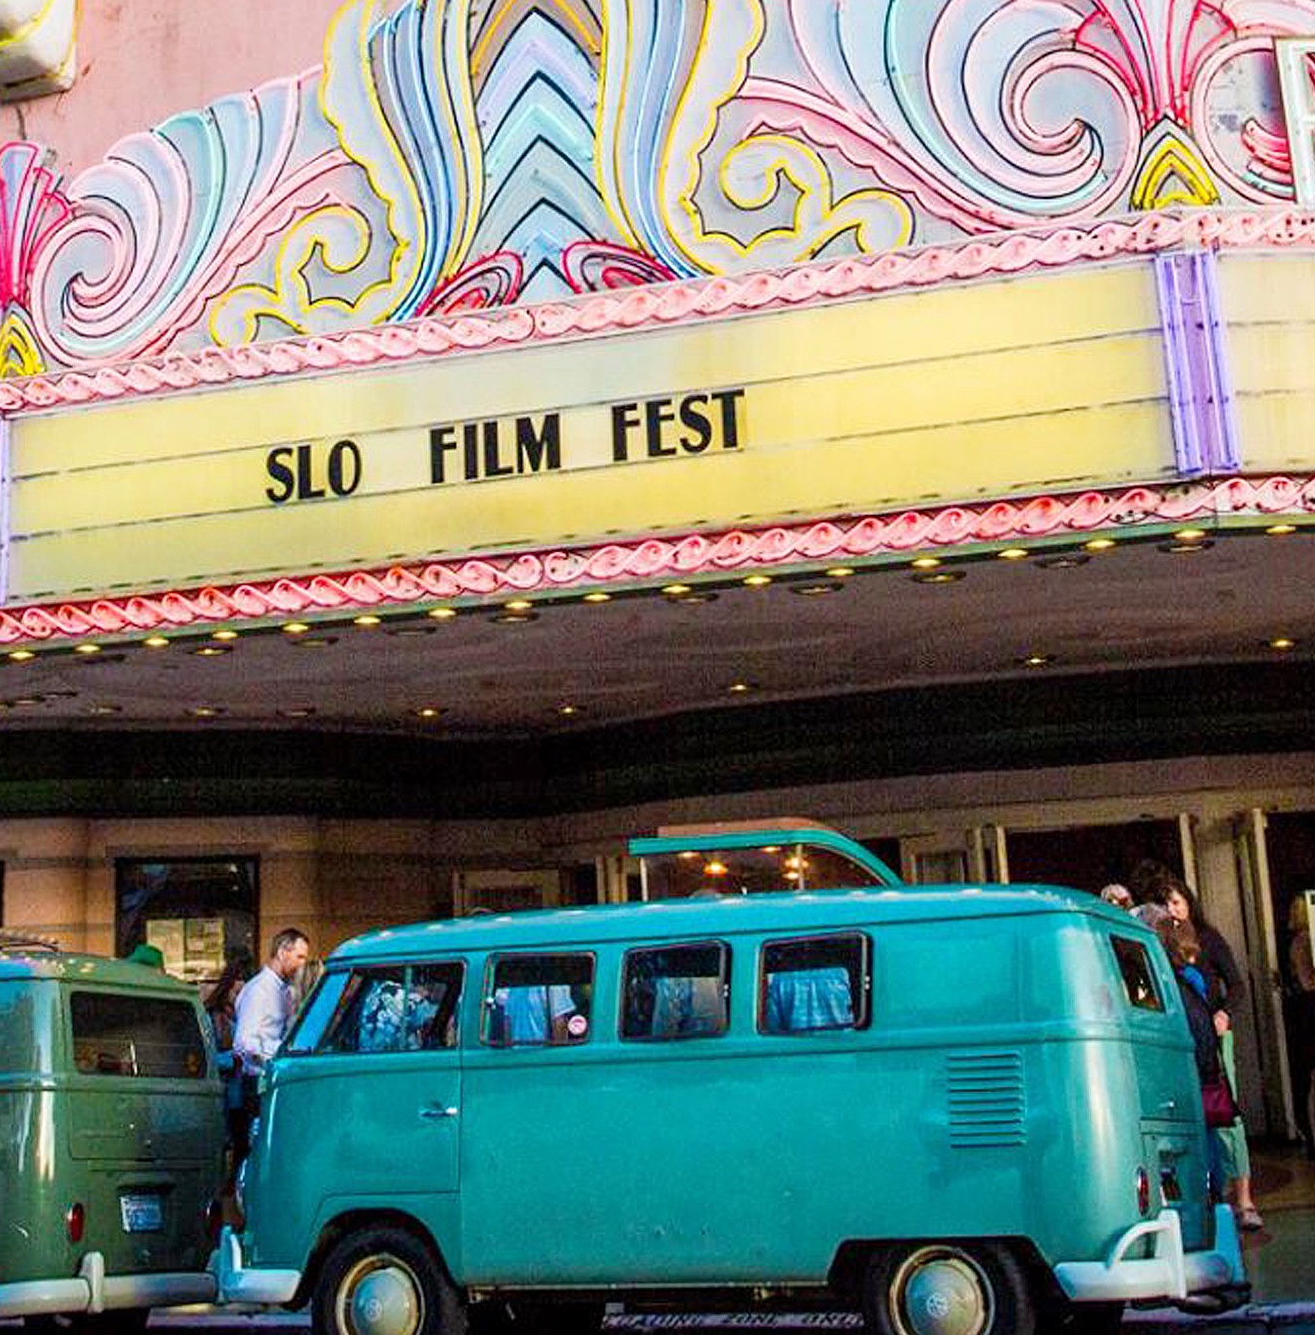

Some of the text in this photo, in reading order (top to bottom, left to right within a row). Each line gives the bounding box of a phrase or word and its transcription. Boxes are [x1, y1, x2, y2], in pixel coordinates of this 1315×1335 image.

[264, 388, 746, 504] SLO FILM FEST
